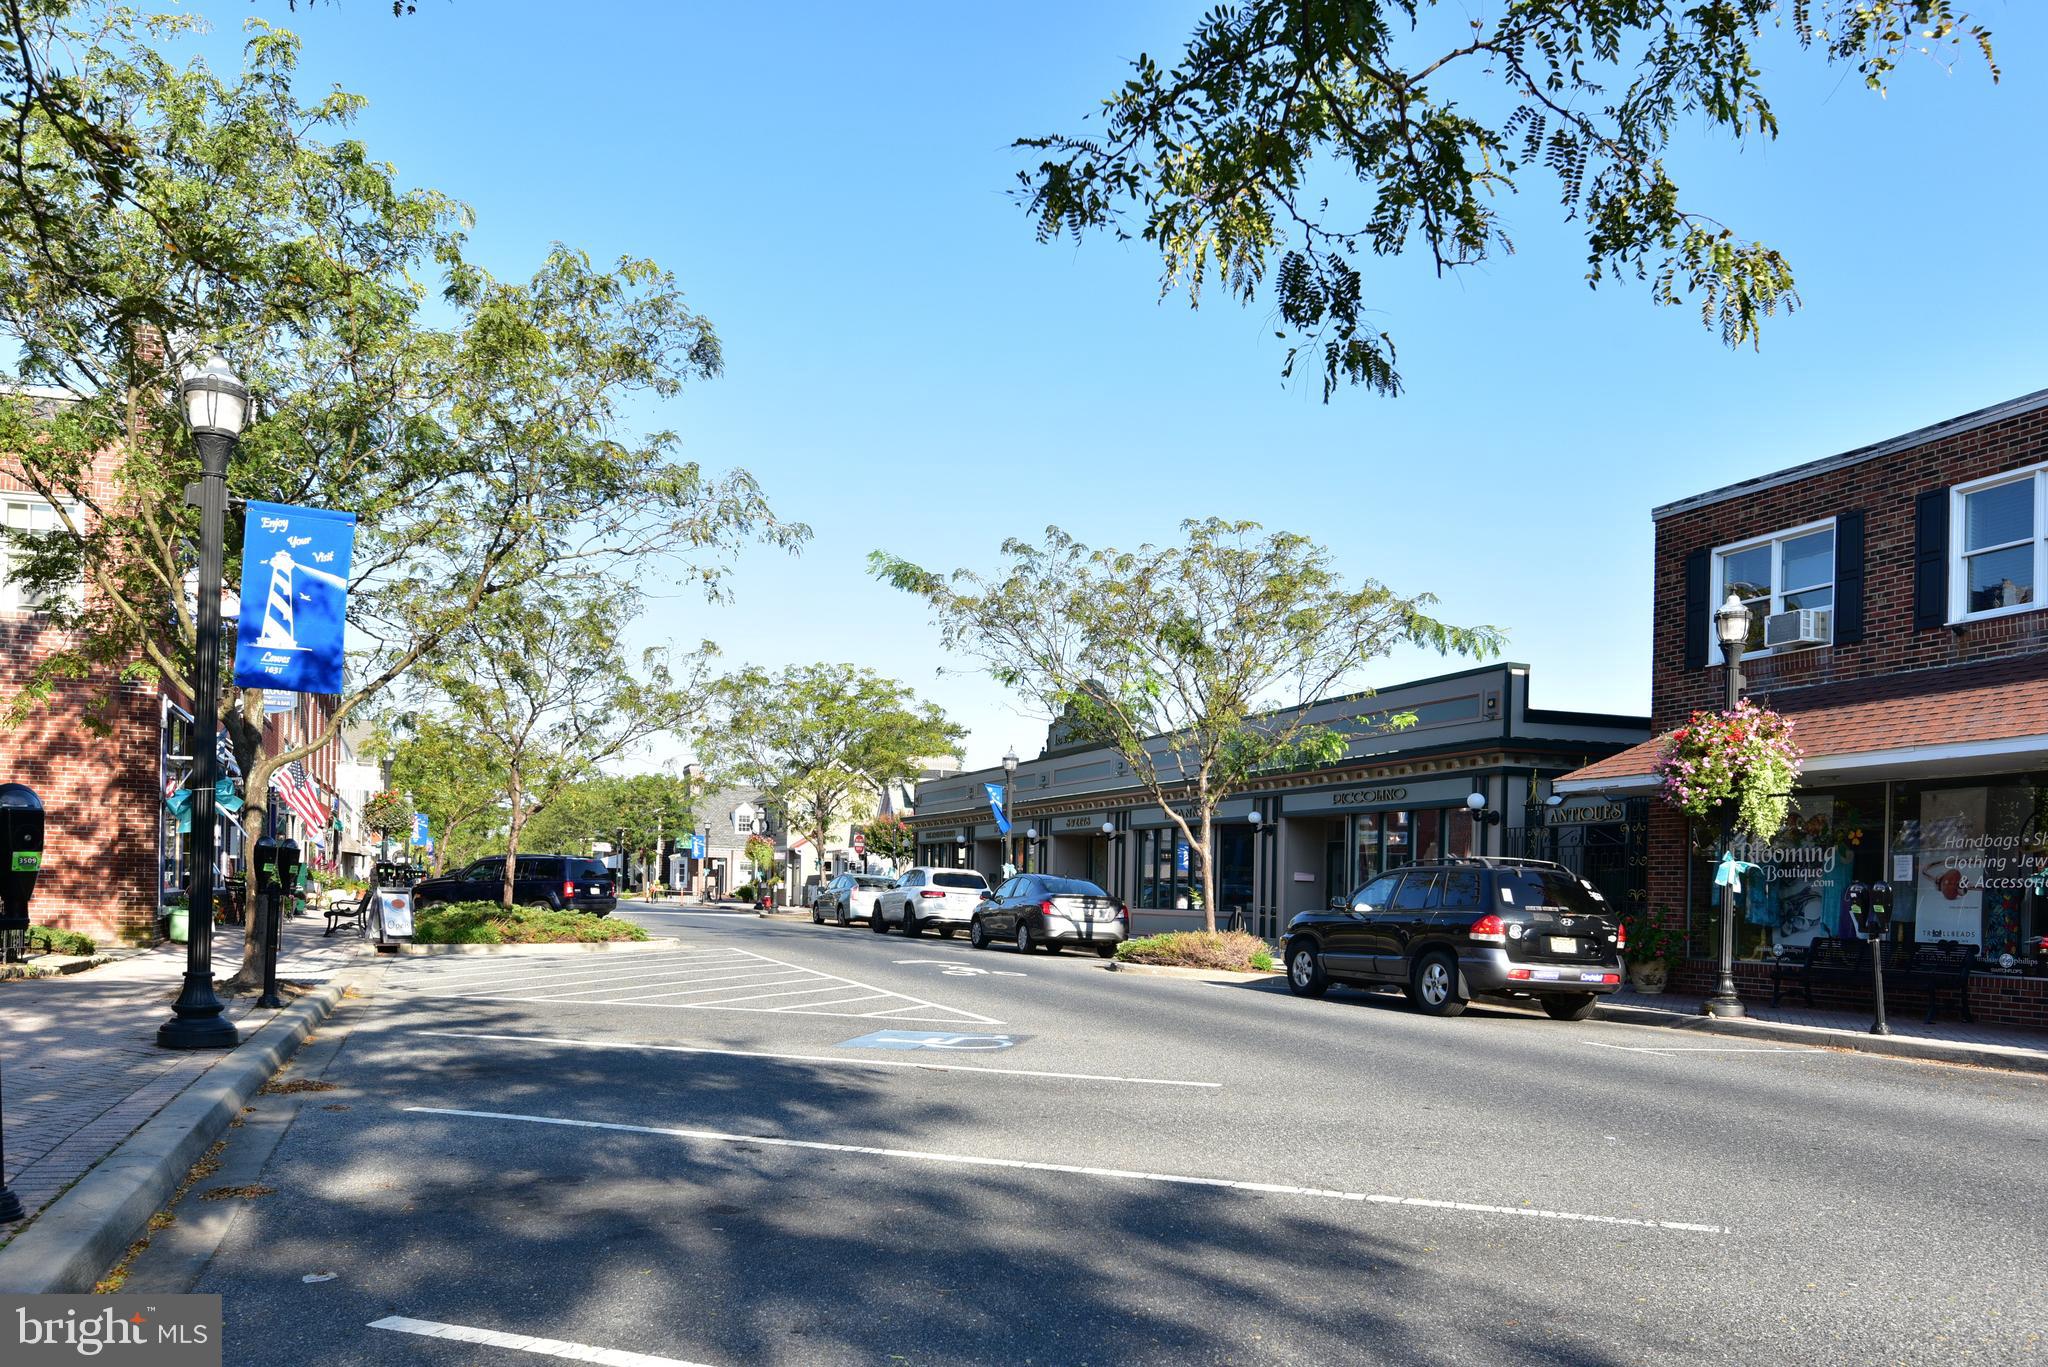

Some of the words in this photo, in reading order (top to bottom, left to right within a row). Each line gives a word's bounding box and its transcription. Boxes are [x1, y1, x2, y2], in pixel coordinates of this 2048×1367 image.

[260, 517, 289, 533] Enjoy
[287, 535, 312, 548] Your
[312, 550, 335, 563] Visit
[261, 651, 291, 664] Lewes
[264, 665, 283, 675] 1631
[1333, 788, 1407, 805] PICCOLINO
[1550, 803, 1622, 823] ANTIQUES
[1944, 833, 2020, 851] Handbags
[1735, 842, 1837, 873] Blooming
[1944, 853, 2007, 872] Clothing
[1762, 864, 1823, 882] Boutique
[1811, 879, 1834, 887] .com
[1959, 875, 1969, 889] &
[2014, 957, 2038, 968] phillips
